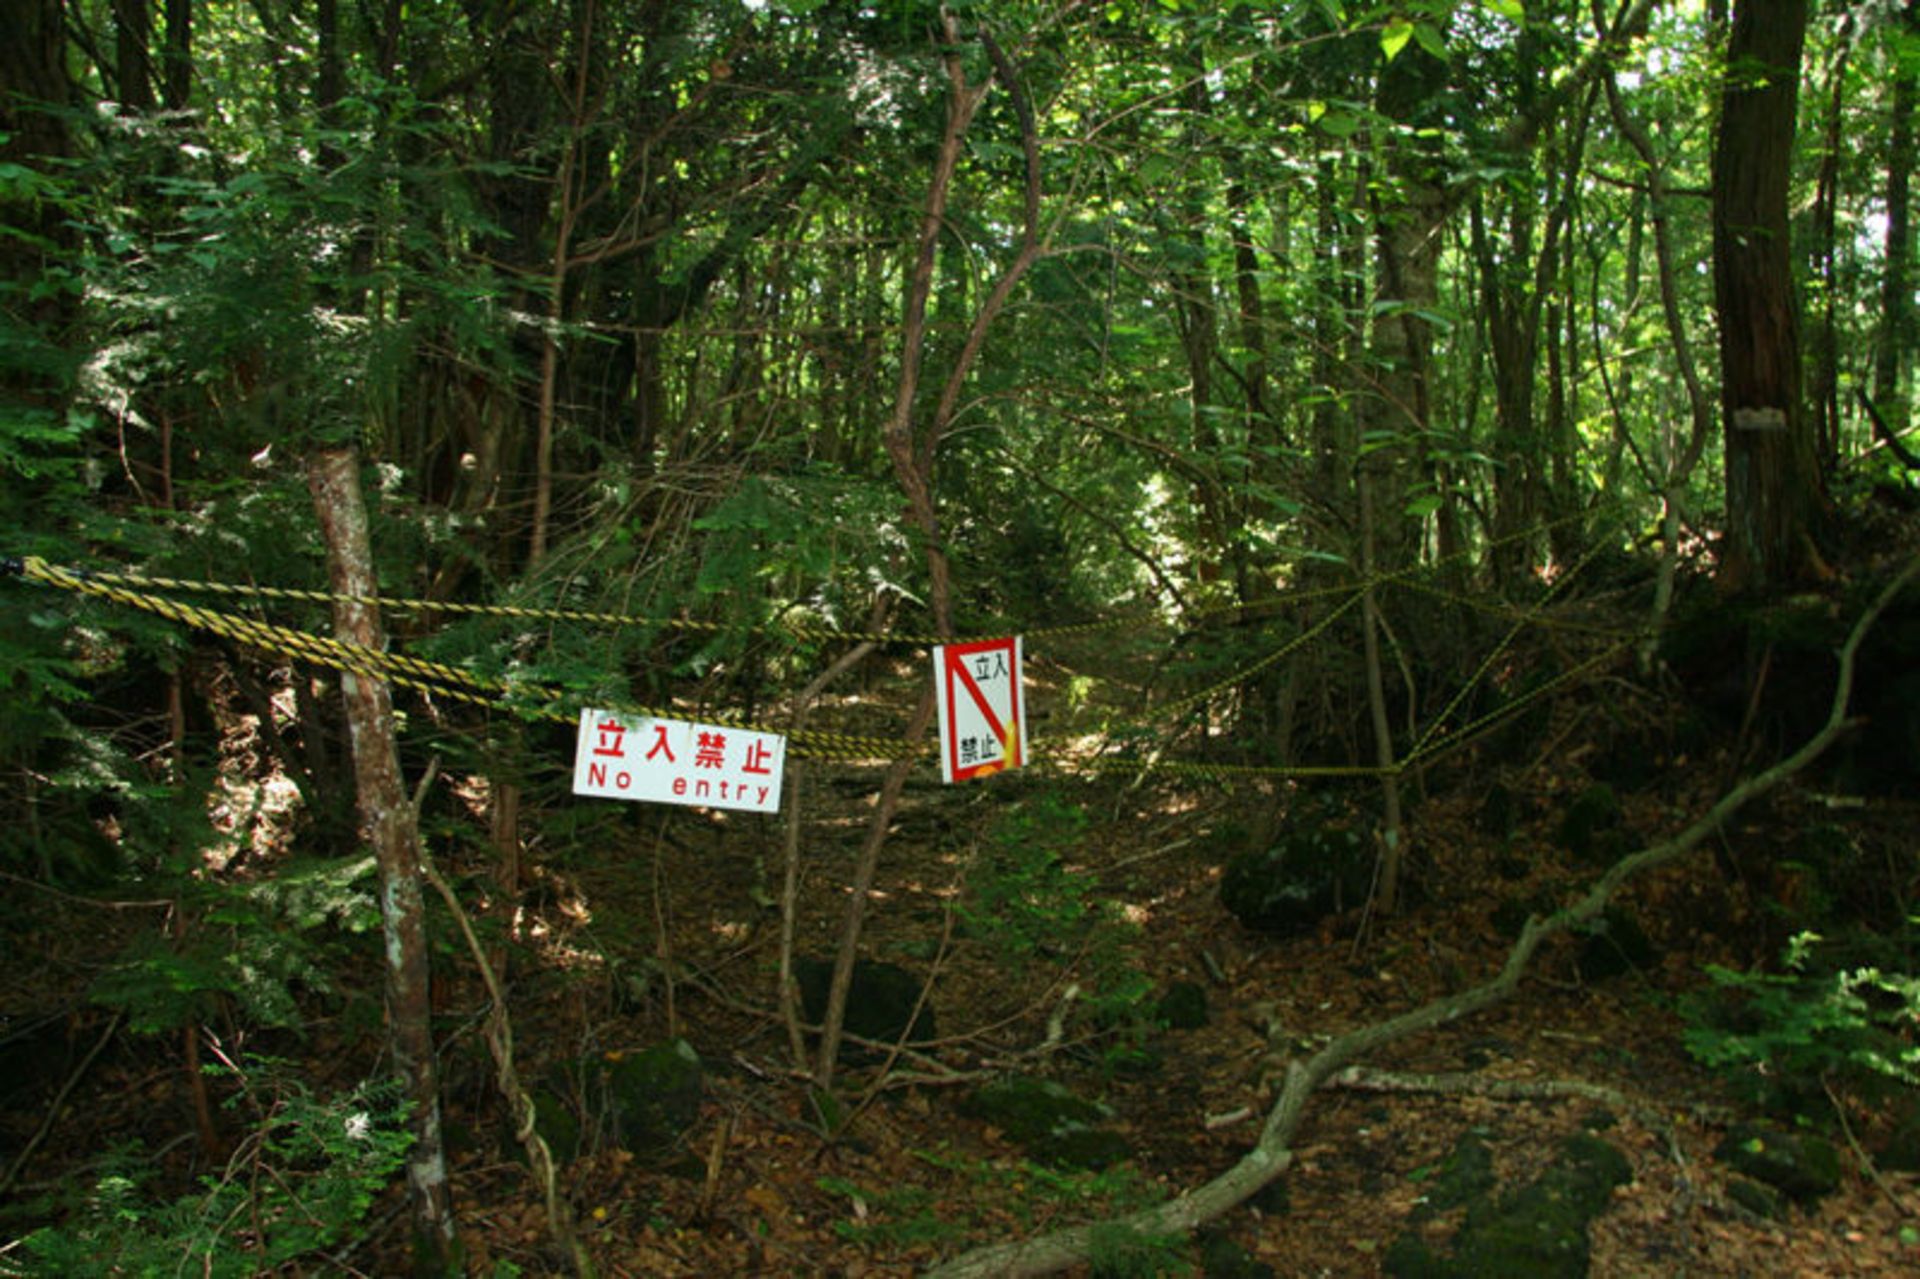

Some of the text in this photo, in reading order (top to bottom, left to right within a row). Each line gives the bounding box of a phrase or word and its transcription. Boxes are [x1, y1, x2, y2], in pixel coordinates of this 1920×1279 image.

[975, 653, 1008, 681] 立入
[593, 719, 772, 775] 立入禁止
[960, 733, 997, 763] 禁止
[587, 762, 769, 804] No entry
